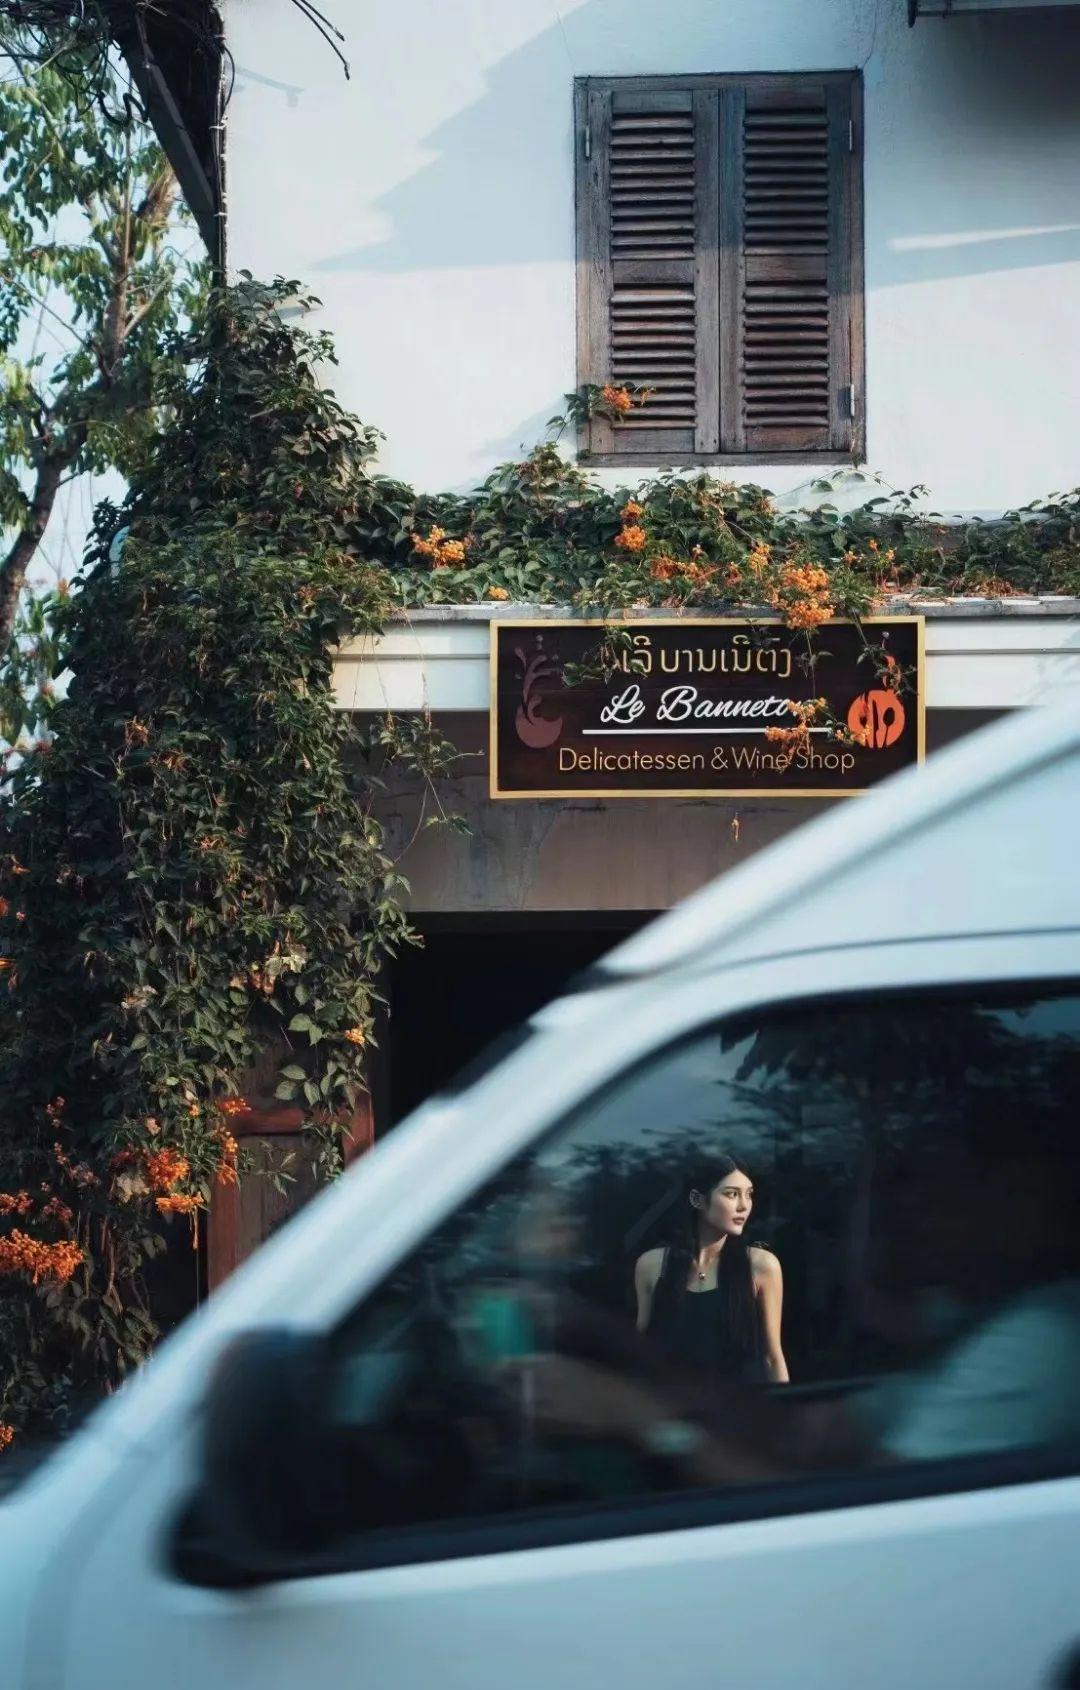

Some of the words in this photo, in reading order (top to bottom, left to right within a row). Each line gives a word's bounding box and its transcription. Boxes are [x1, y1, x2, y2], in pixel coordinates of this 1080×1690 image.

[600, 684, 645, 724] Le
[656, 685, 803, 722] Banneto
[559, 747, 704, 771] Delicatessen
[711, 748, 729, 770] &
[731, 747, 789, 770] Wine
[796, 745, 855, 775] Shop
